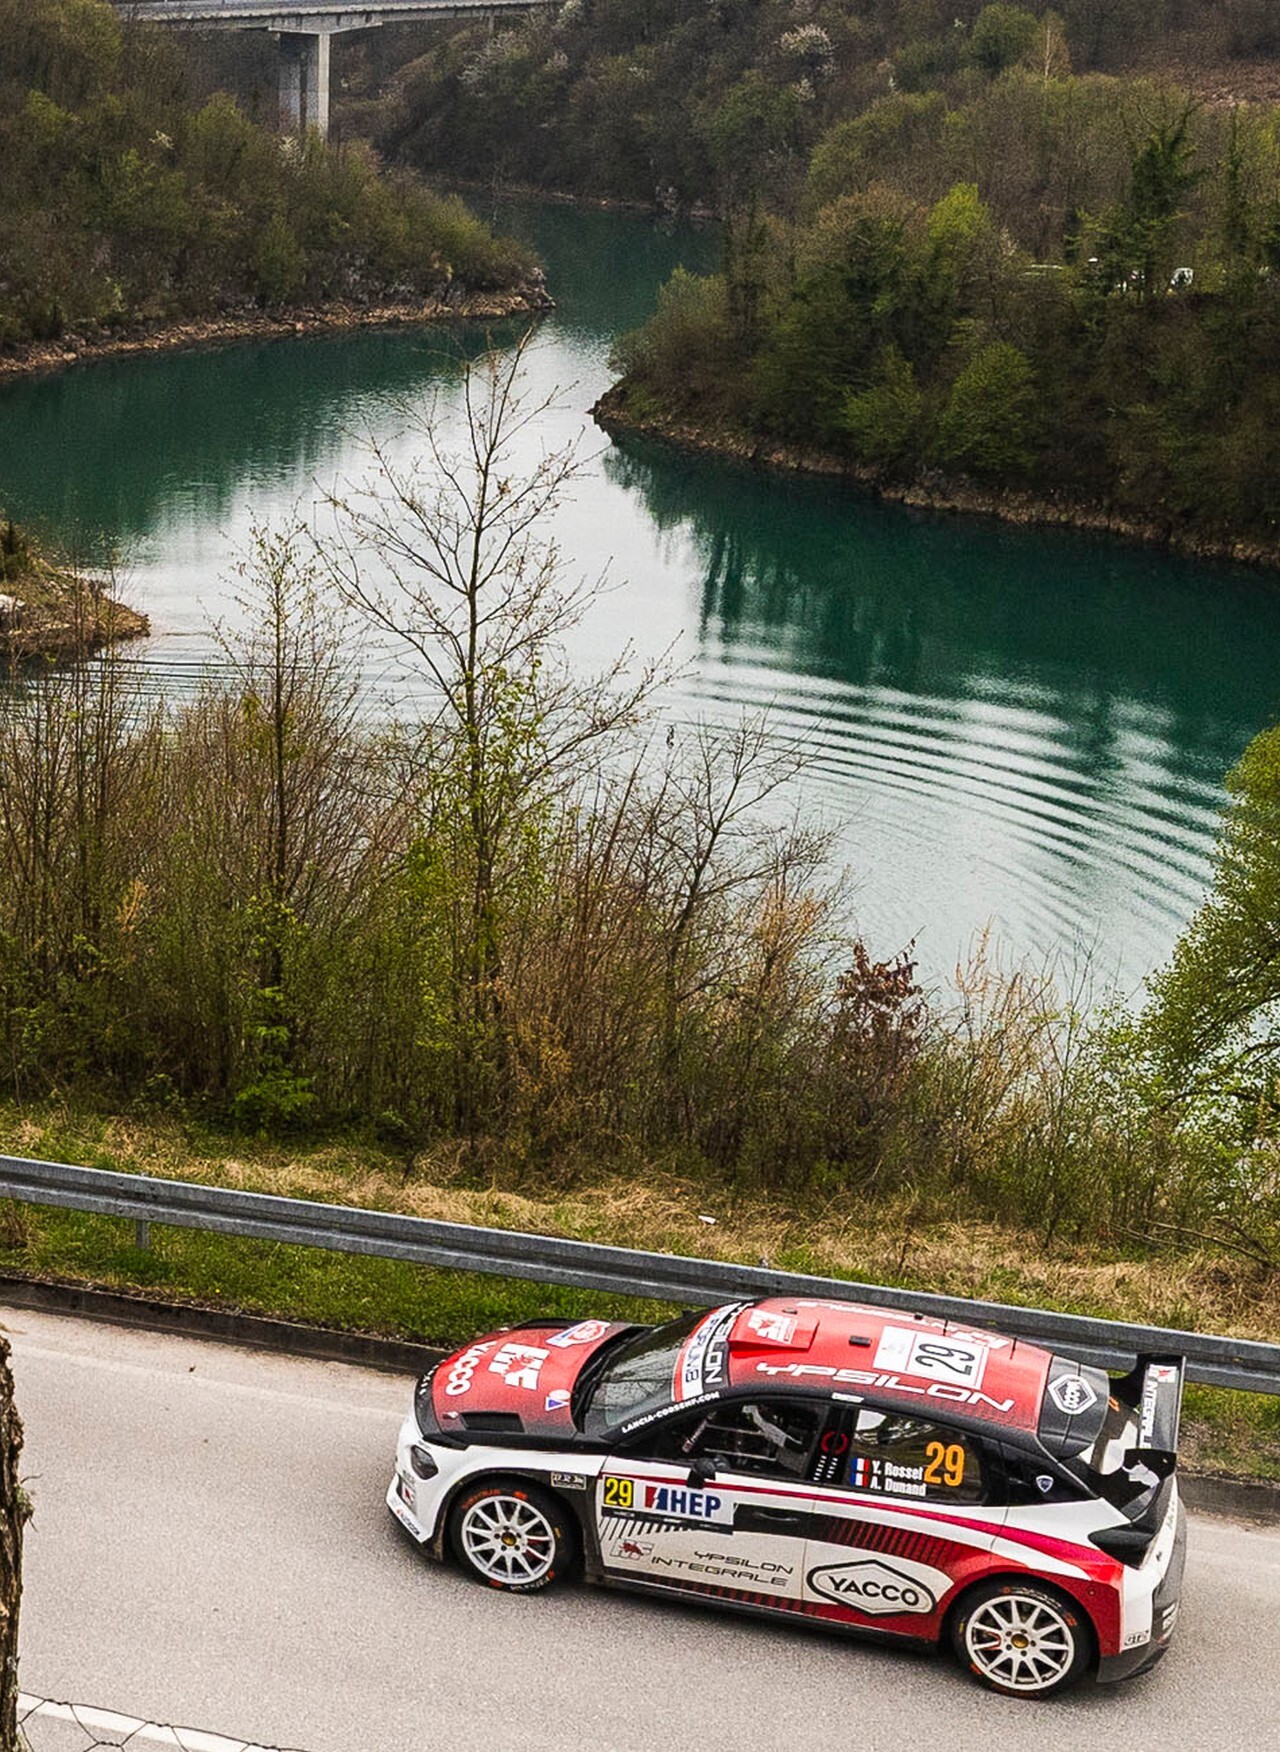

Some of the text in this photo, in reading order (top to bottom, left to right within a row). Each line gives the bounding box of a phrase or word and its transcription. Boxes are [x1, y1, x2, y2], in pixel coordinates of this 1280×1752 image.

[445, 1341, 497, 1396] YACCO
[915, 1343, 975, 1376] 29
[756, 1362, 1014, 1412] YPSILON
[923, 1441, 965, 1487] 29
[604, 1477, 633, 1507] 29
[651, 1556, 789, 1587] INTEGRALE
[694, 1551, 794, 1575] YPSILON
[827, 1576, 920, 1606] YACCO
